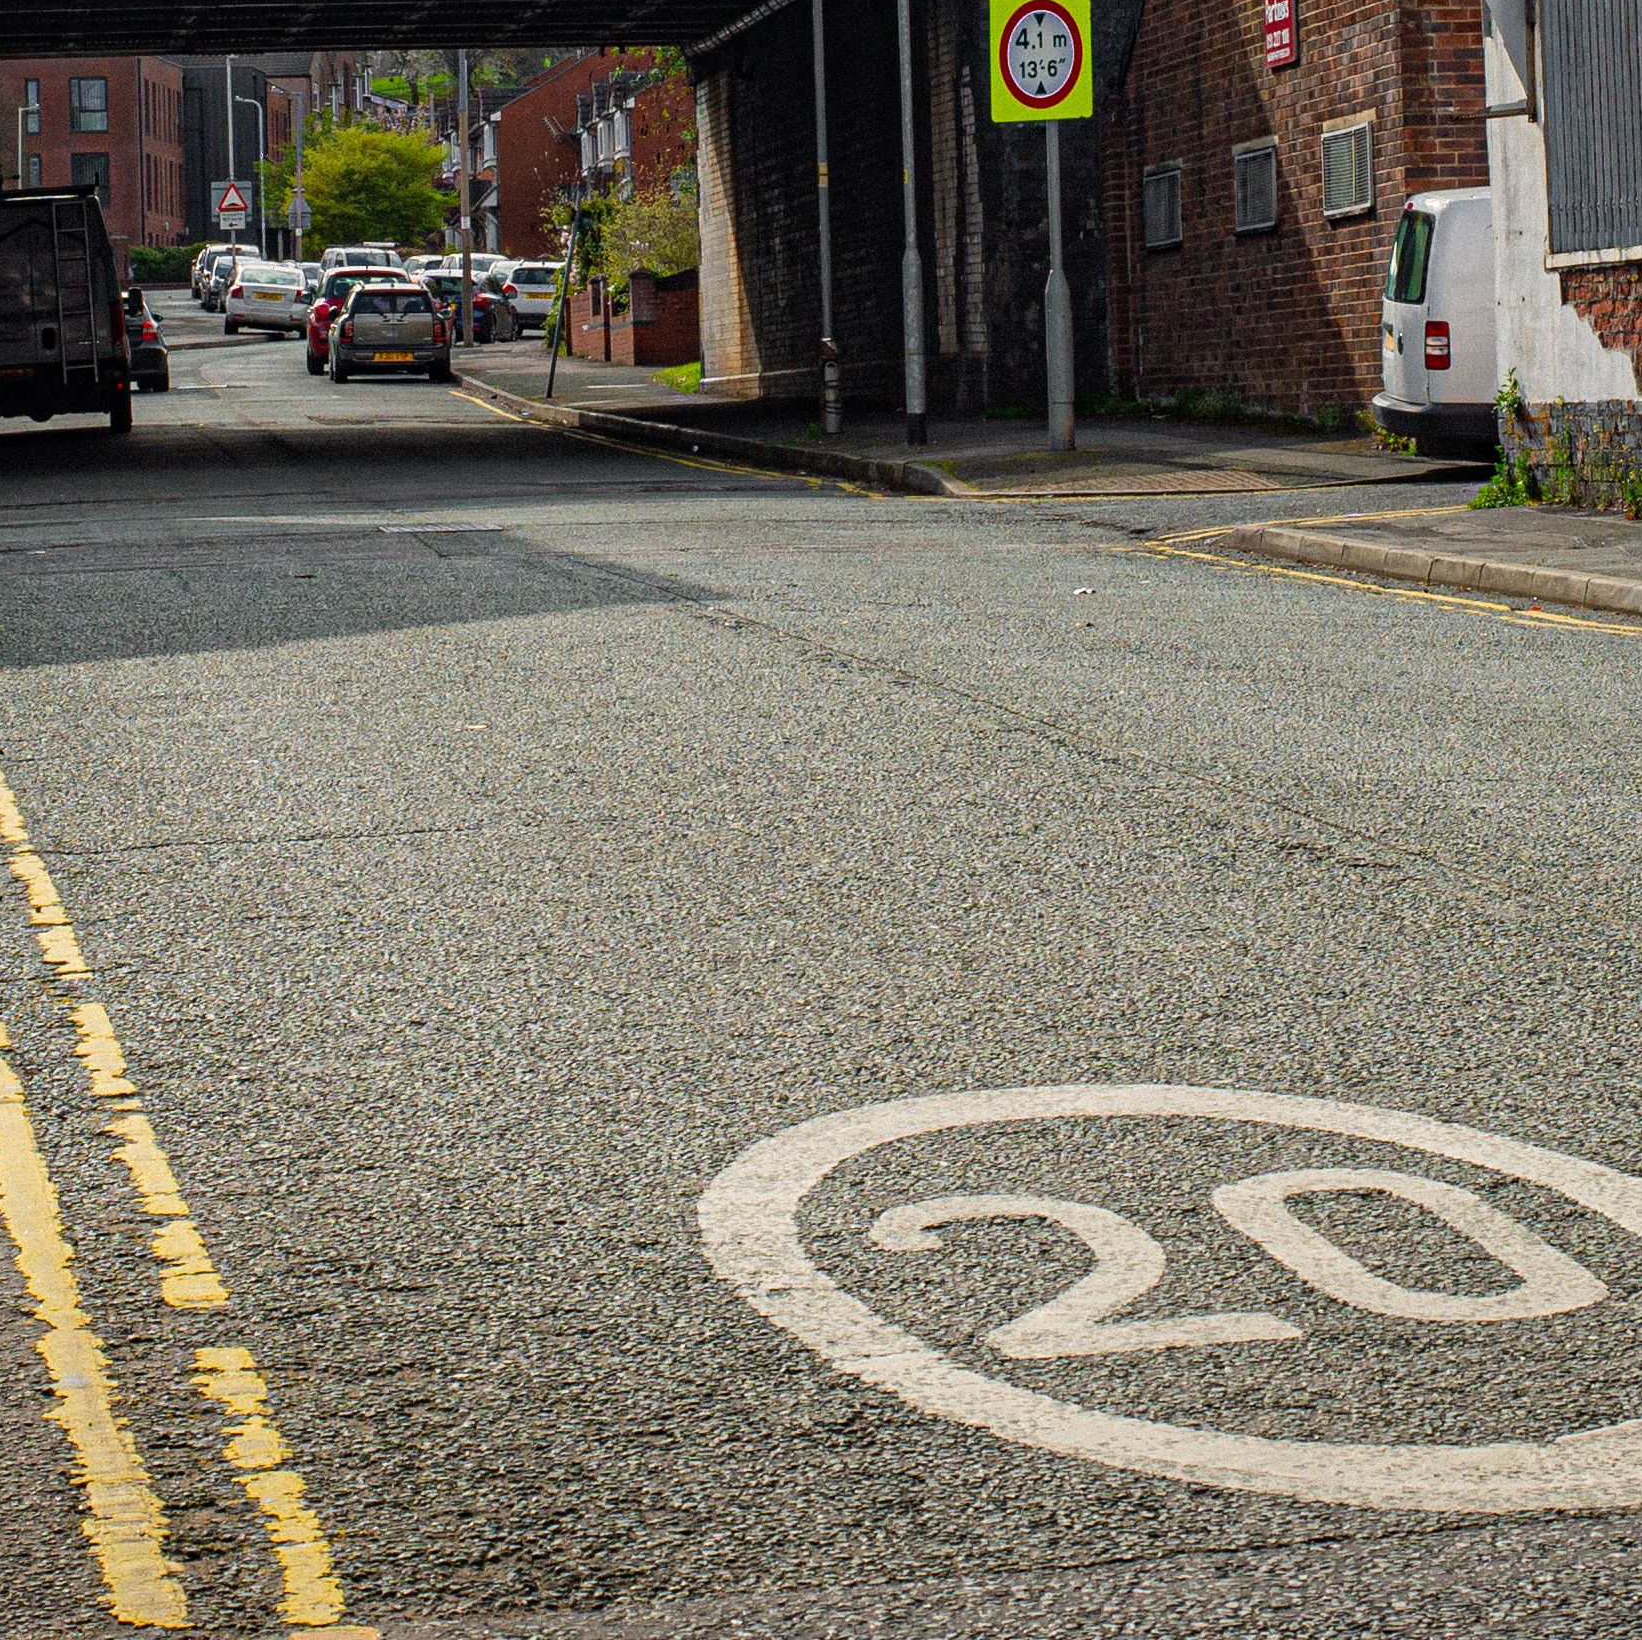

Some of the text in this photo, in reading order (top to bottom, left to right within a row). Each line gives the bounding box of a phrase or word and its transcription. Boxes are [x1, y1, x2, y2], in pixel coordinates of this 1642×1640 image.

[1015, 28, 1067, 50] 4.1 m
[1019, 57, 1066, 80] 13'-6"
[868, 1167, 1609, 1361] 20
